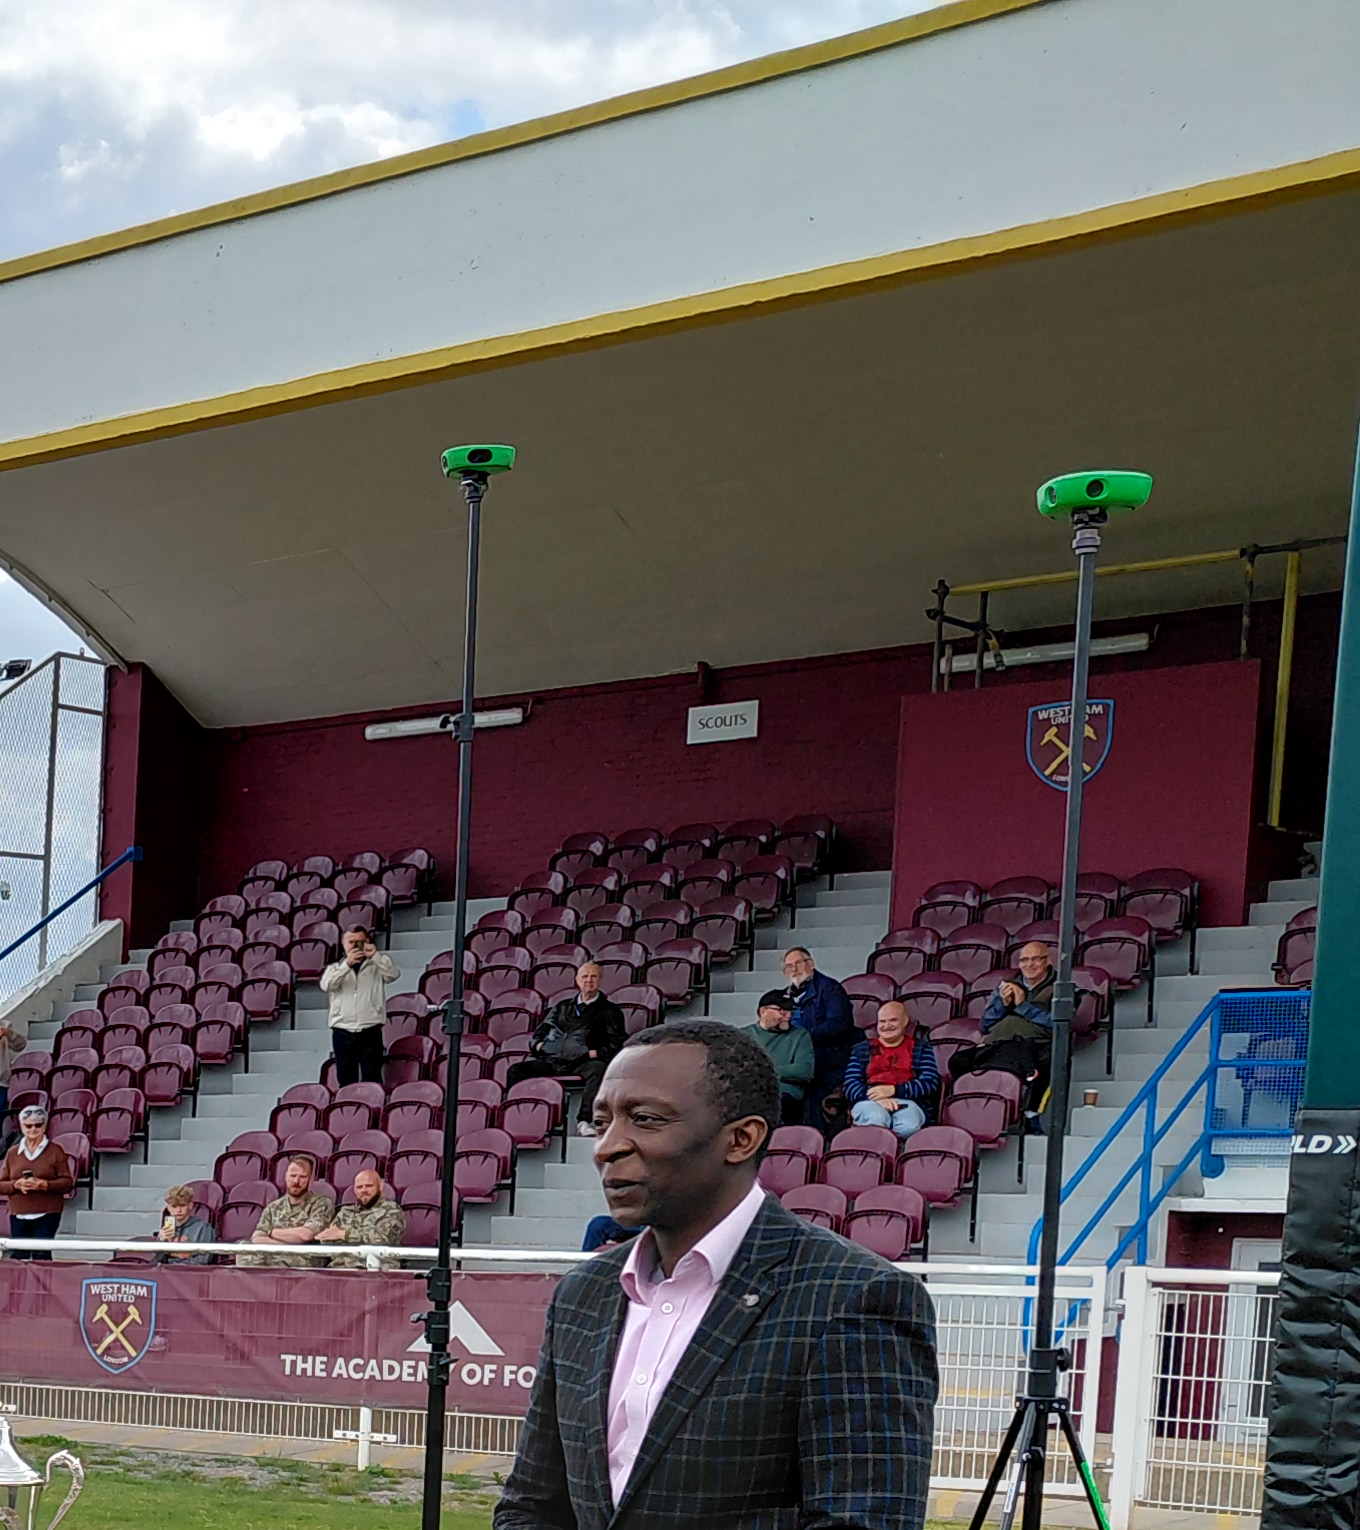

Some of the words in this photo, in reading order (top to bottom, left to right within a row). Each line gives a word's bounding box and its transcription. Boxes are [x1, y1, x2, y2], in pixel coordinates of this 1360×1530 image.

[1038, 706, 1071, 720] WEST
[698, 713, 748, 730] SCOUTS
[1291, 1135, 1333, 1153] LD
[91, 1284, 120, 1295] WEST
[121, 1285, 147, 1297] HAM
[102, 1293, 135, 1303] UNITED
[280, 1354, 328, 1377] THE
[460, 1364, 498, 1387] OF
